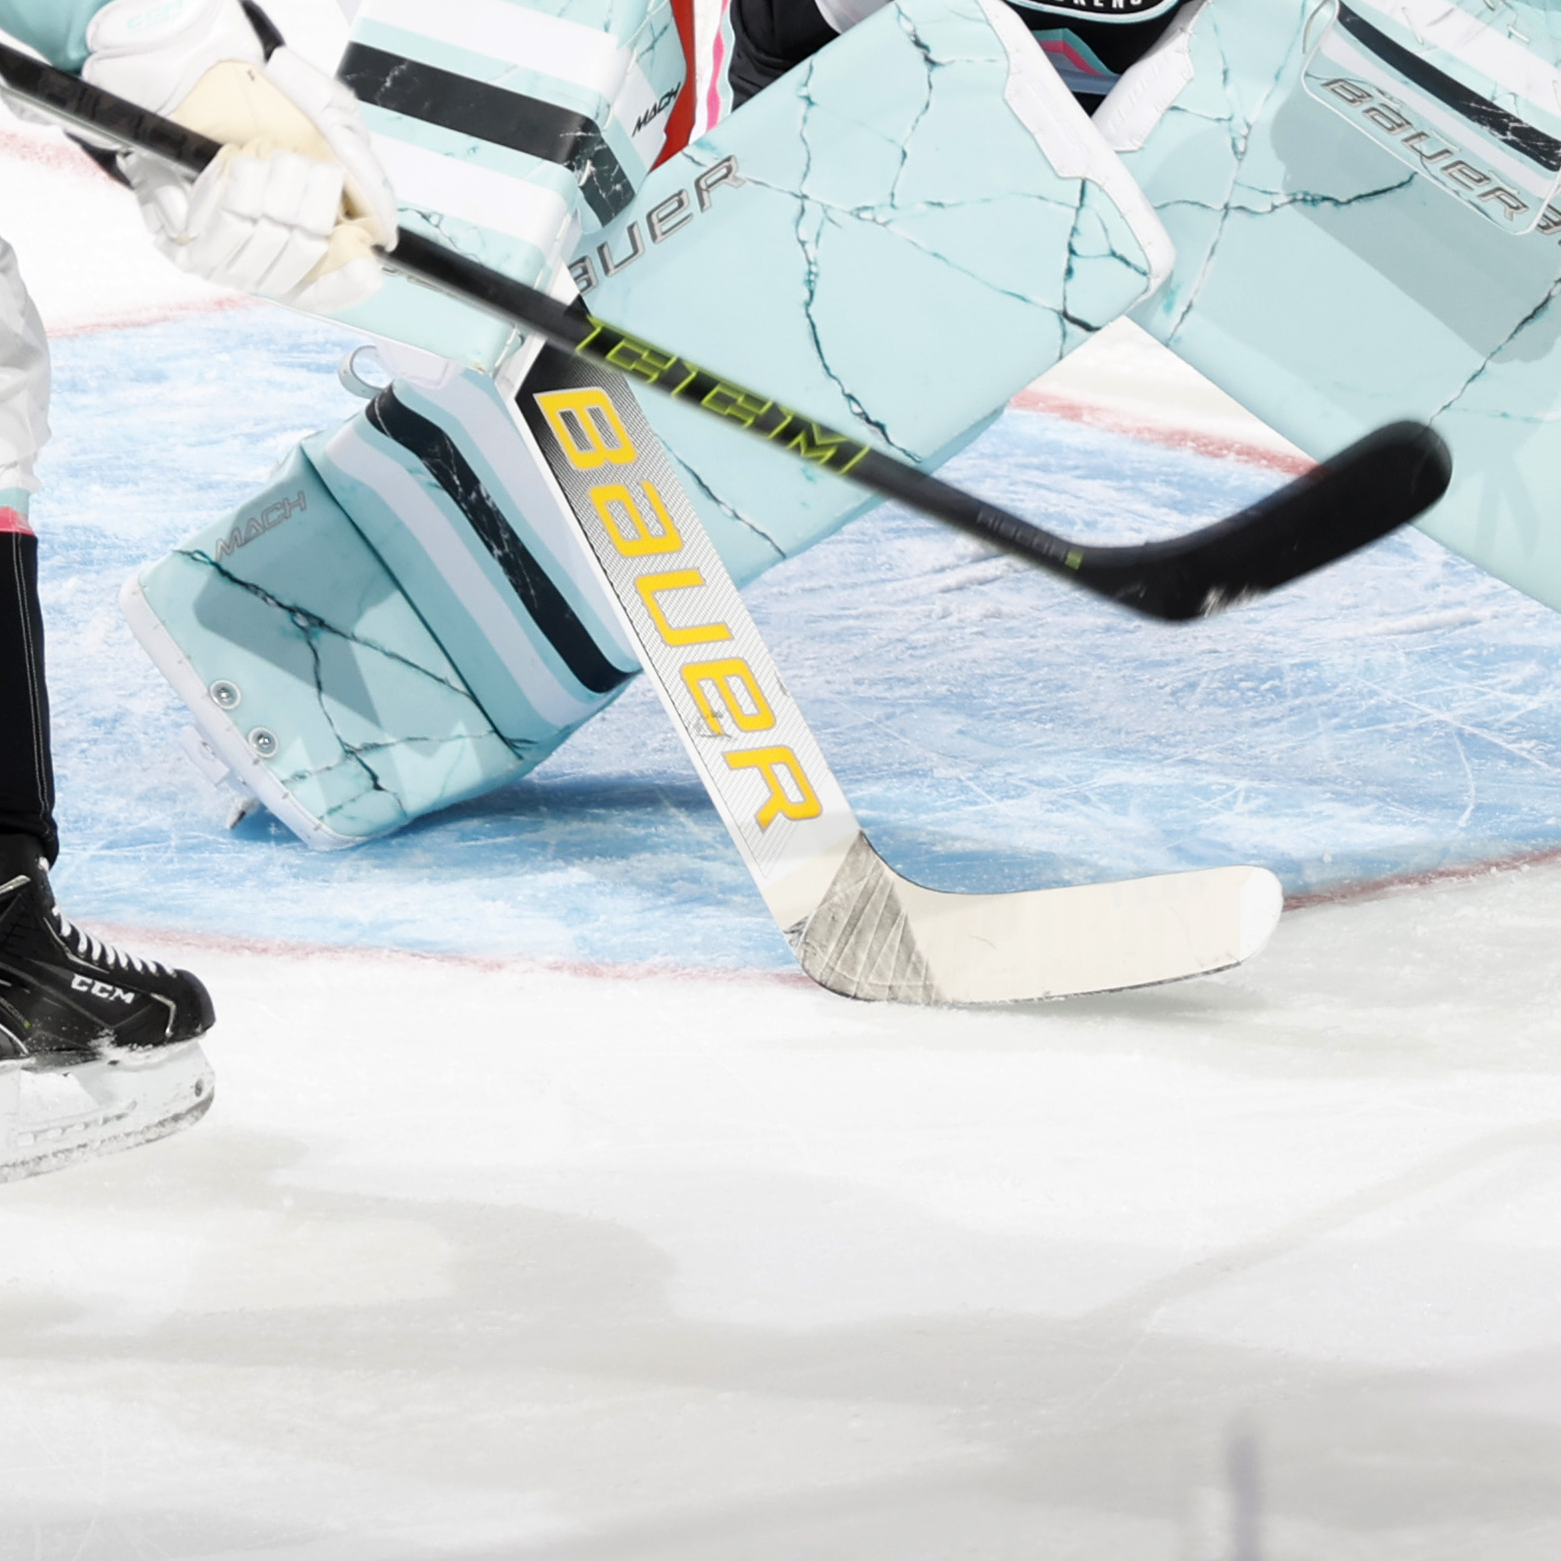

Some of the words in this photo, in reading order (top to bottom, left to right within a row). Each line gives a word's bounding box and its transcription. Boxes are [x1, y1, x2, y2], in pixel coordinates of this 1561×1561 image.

[1321, 77, 1529, 223] BAUER
[567, 154, 746, 296] AUER
[575, 314, 871, 475] CCM
[215, 490, 307, 563] MACH
[533, 386, 822, 834] BAUER
[71, 973, 135, 1004] CCM
